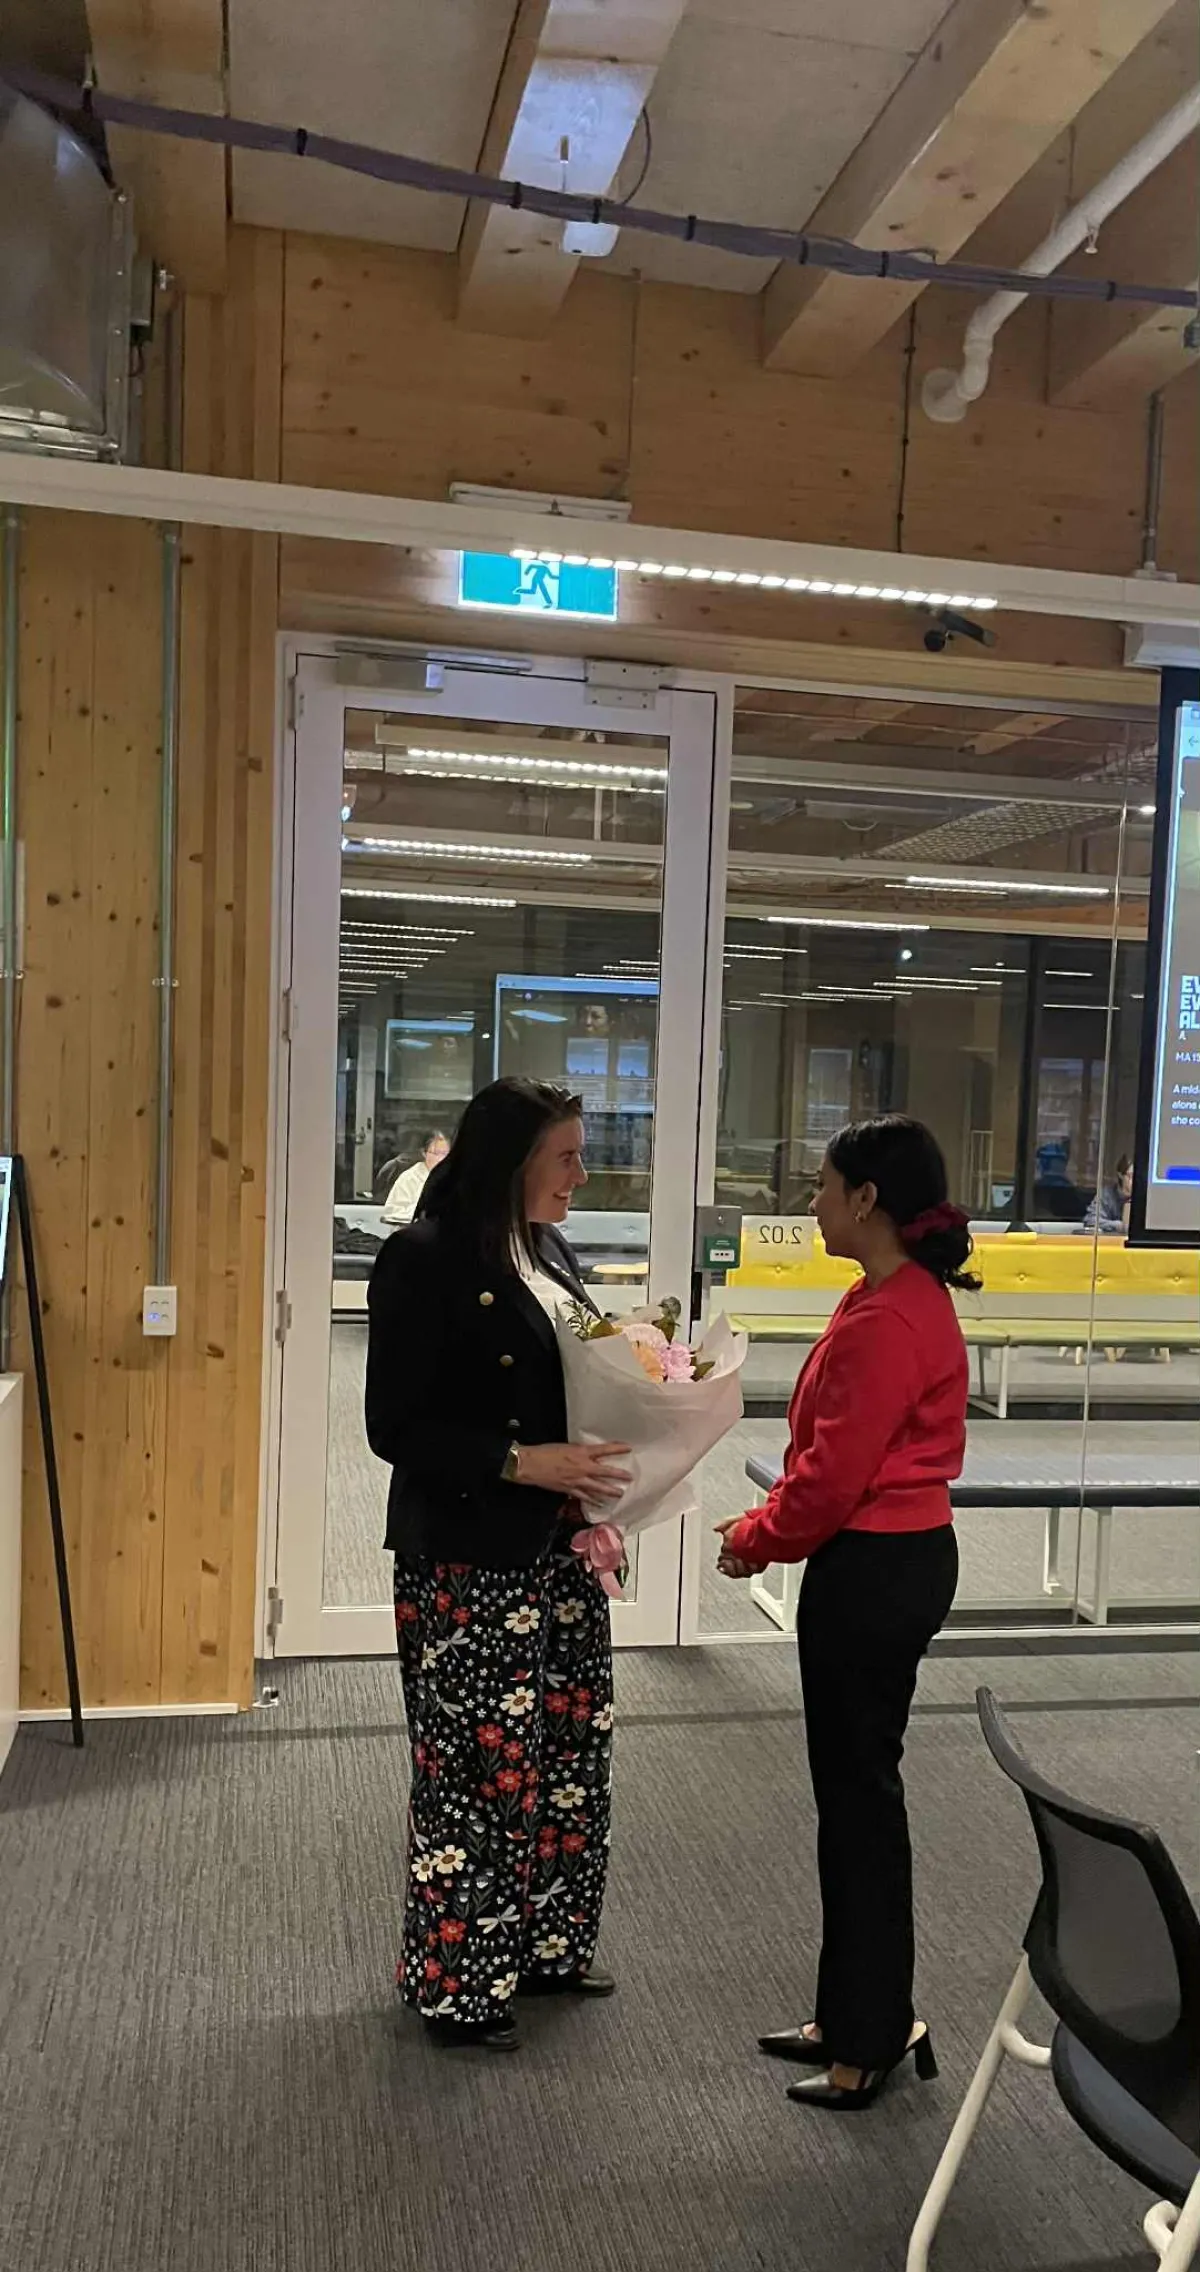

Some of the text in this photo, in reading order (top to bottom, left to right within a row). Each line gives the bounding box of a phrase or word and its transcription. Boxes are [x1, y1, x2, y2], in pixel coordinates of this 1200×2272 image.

[1180, 1010, 1200, 1029] AL
[1175, 1052, 1191, 1062] MA
[1173, 1084, 1180, 1094] A
